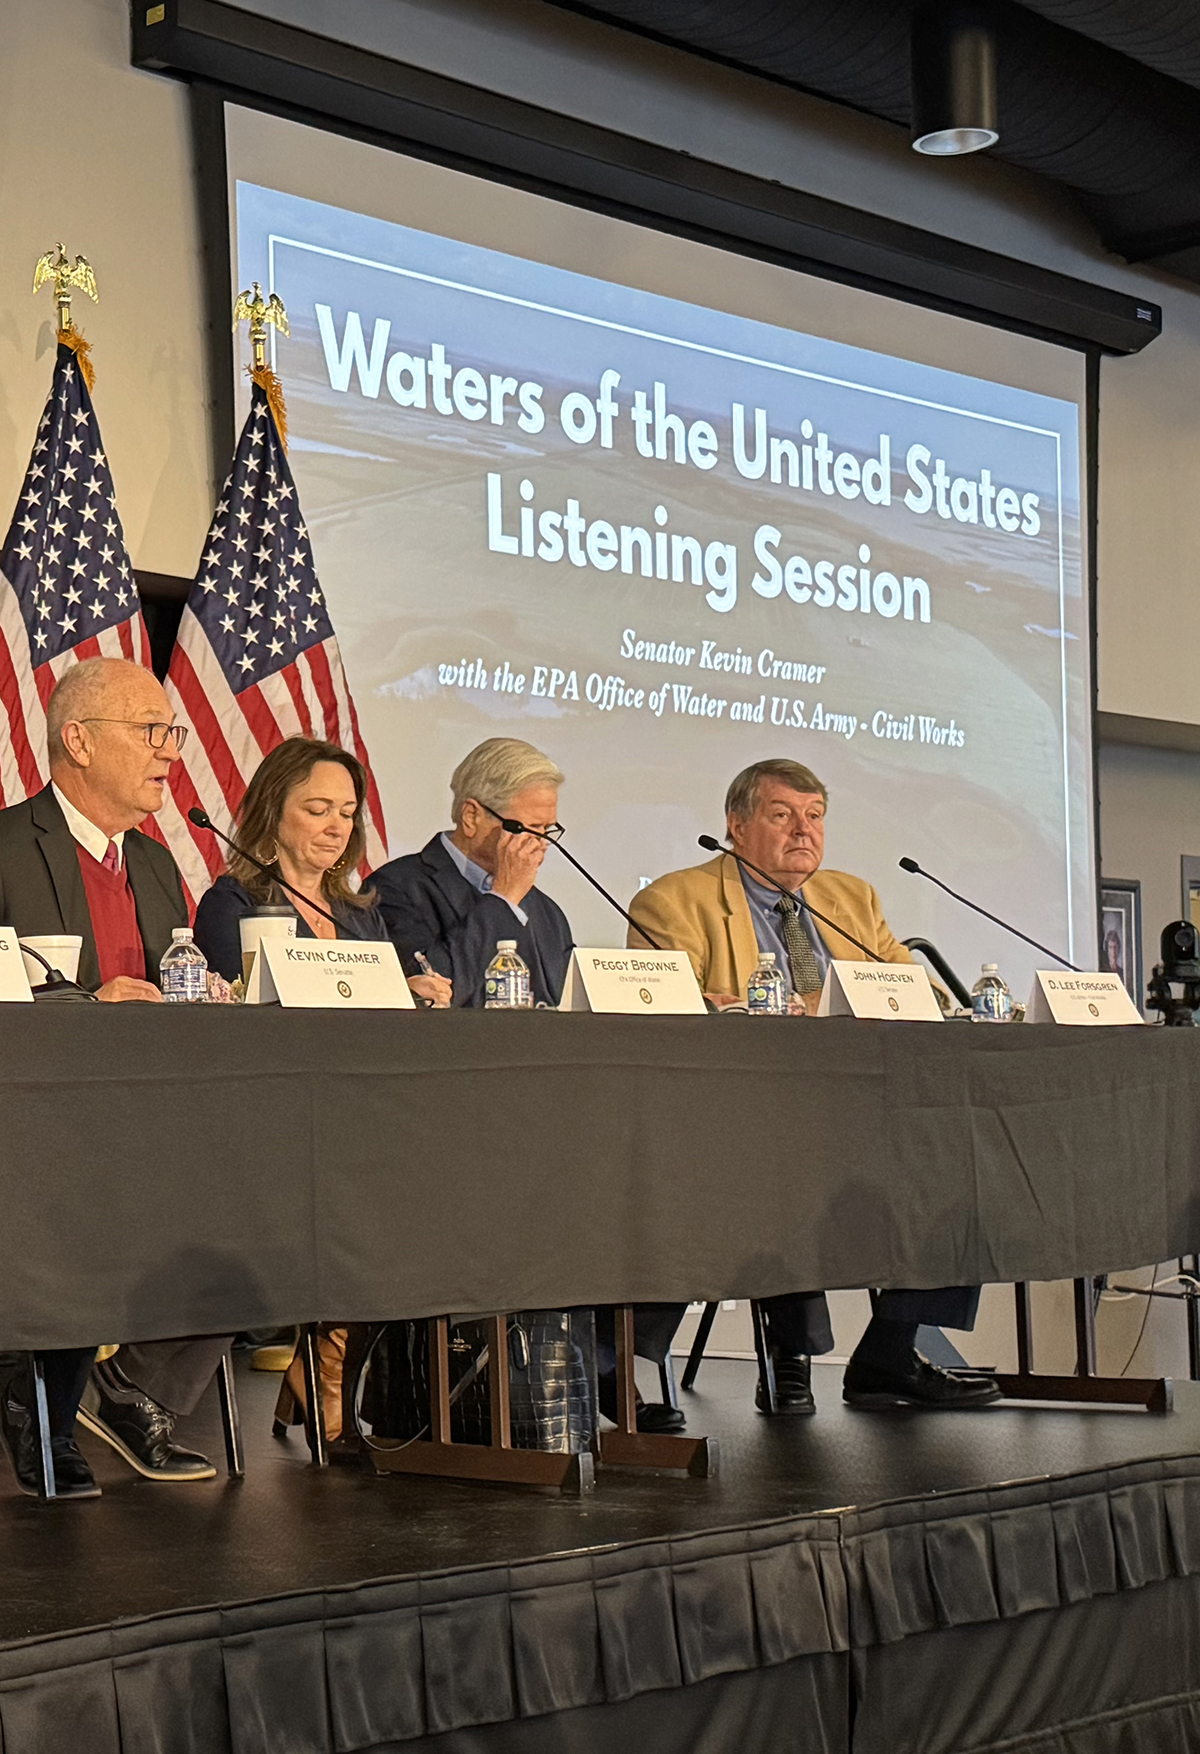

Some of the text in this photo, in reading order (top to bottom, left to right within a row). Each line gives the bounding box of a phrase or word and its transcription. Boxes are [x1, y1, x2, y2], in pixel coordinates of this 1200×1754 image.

[315, 303, 1041, 536] Waters of the United States
[487, 472, 931, 624] Listening Session
[619, 628, 827, 685] Senator Kevin Cramer
[437, 658, 488, 690] with
[492, 661, 526, 694] the
[530, 665, 580, 701] EPA
[585, 672, 646, 712] Office
[648, 682, 671, 718] of
[672, 683, 728, 719] Water
[729, 694, 766, 724] and
[871, 710, 915, 742] Civil
[918, 715, 965, 748] Works
[285, 948, 381, 965] KEVIN CRAMER
[592, 958, 679, 972] PEGGY BROWNE
[853, 970, 915, 983] JOHN HOEVEN
[1048, 979, 1118, 991] D. LEE FORSGREN
